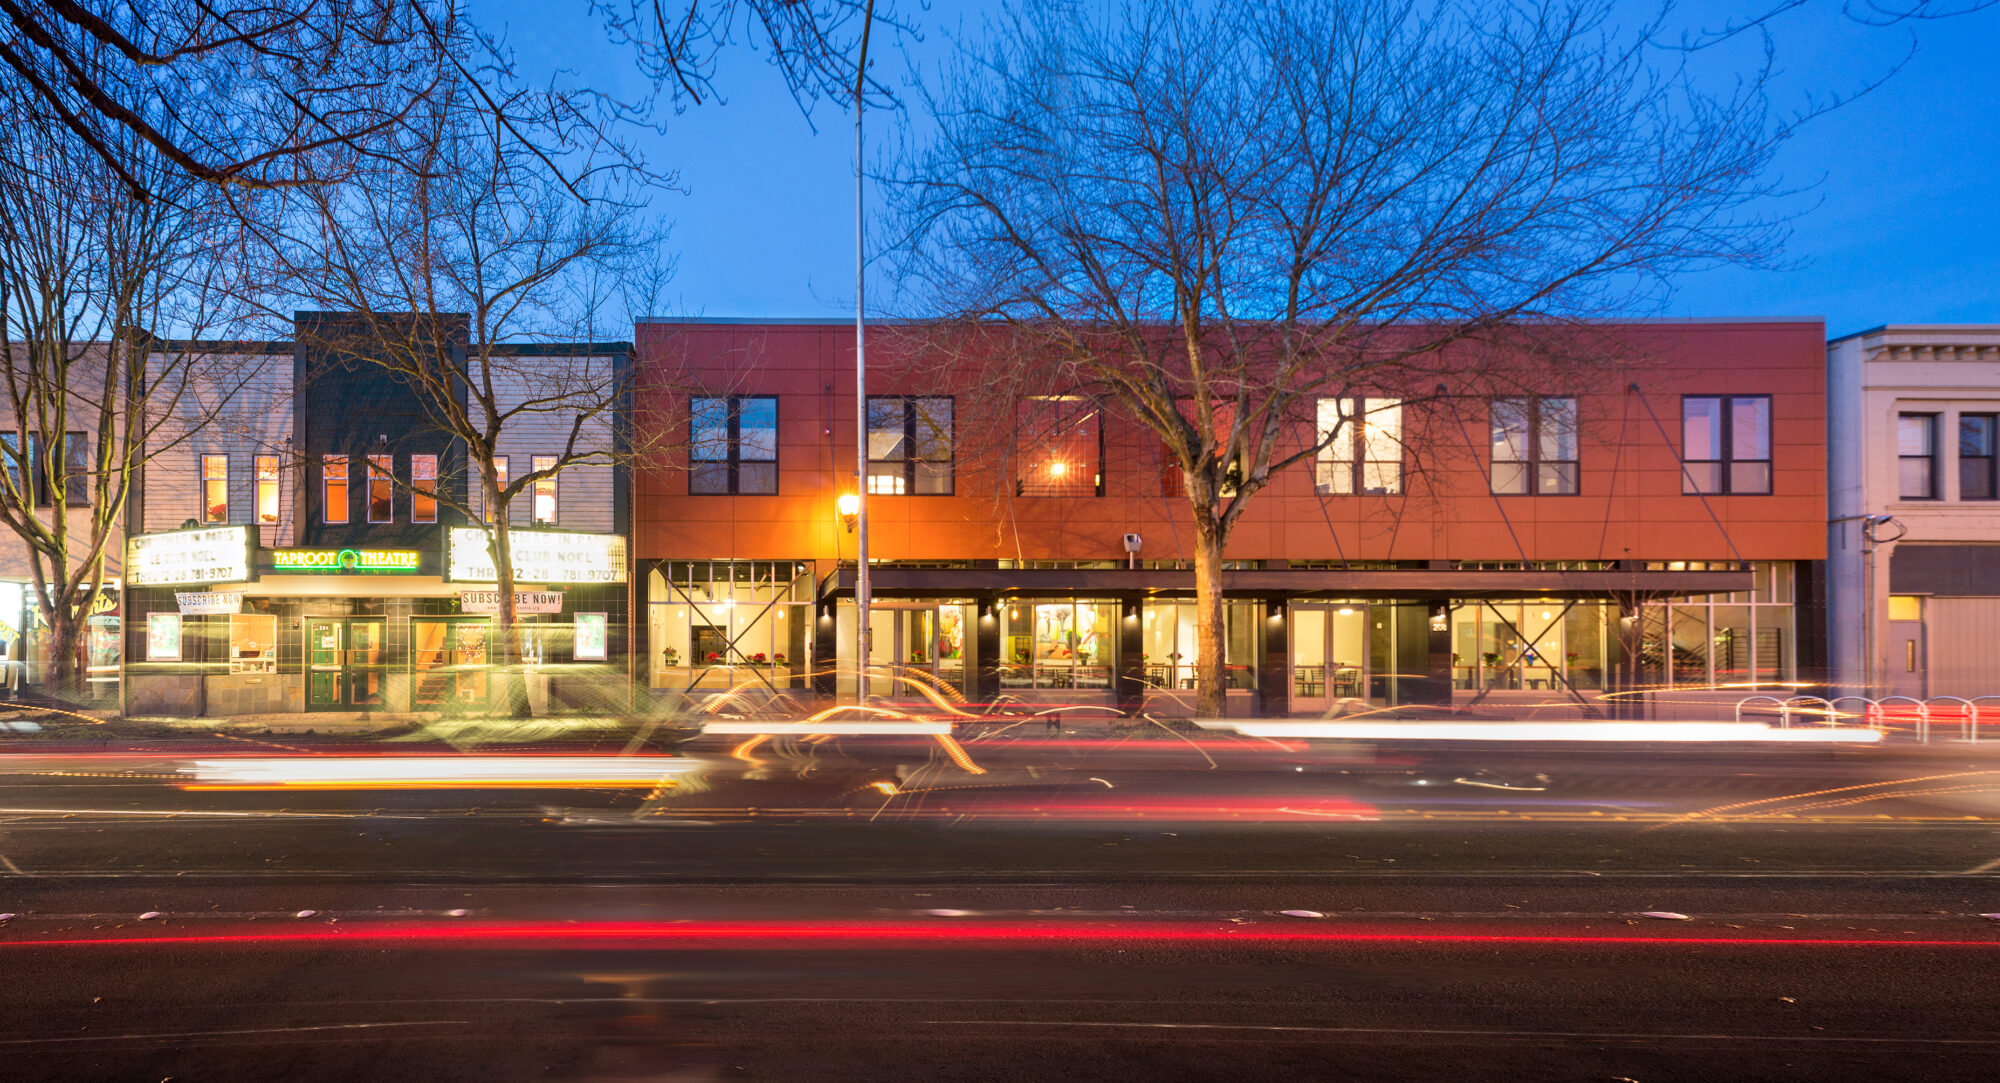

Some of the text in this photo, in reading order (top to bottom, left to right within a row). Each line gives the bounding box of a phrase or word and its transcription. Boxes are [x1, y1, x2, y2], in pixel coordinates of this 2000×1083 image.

[273, 552, 417, 567] TAPROOT THEATRE
[515, 550, 593, 563] CLUB NOEL
[178, 594, 220, 606] SUBSCRIBE
[463, 592, 561, 605] SUBSCBE NOW!
